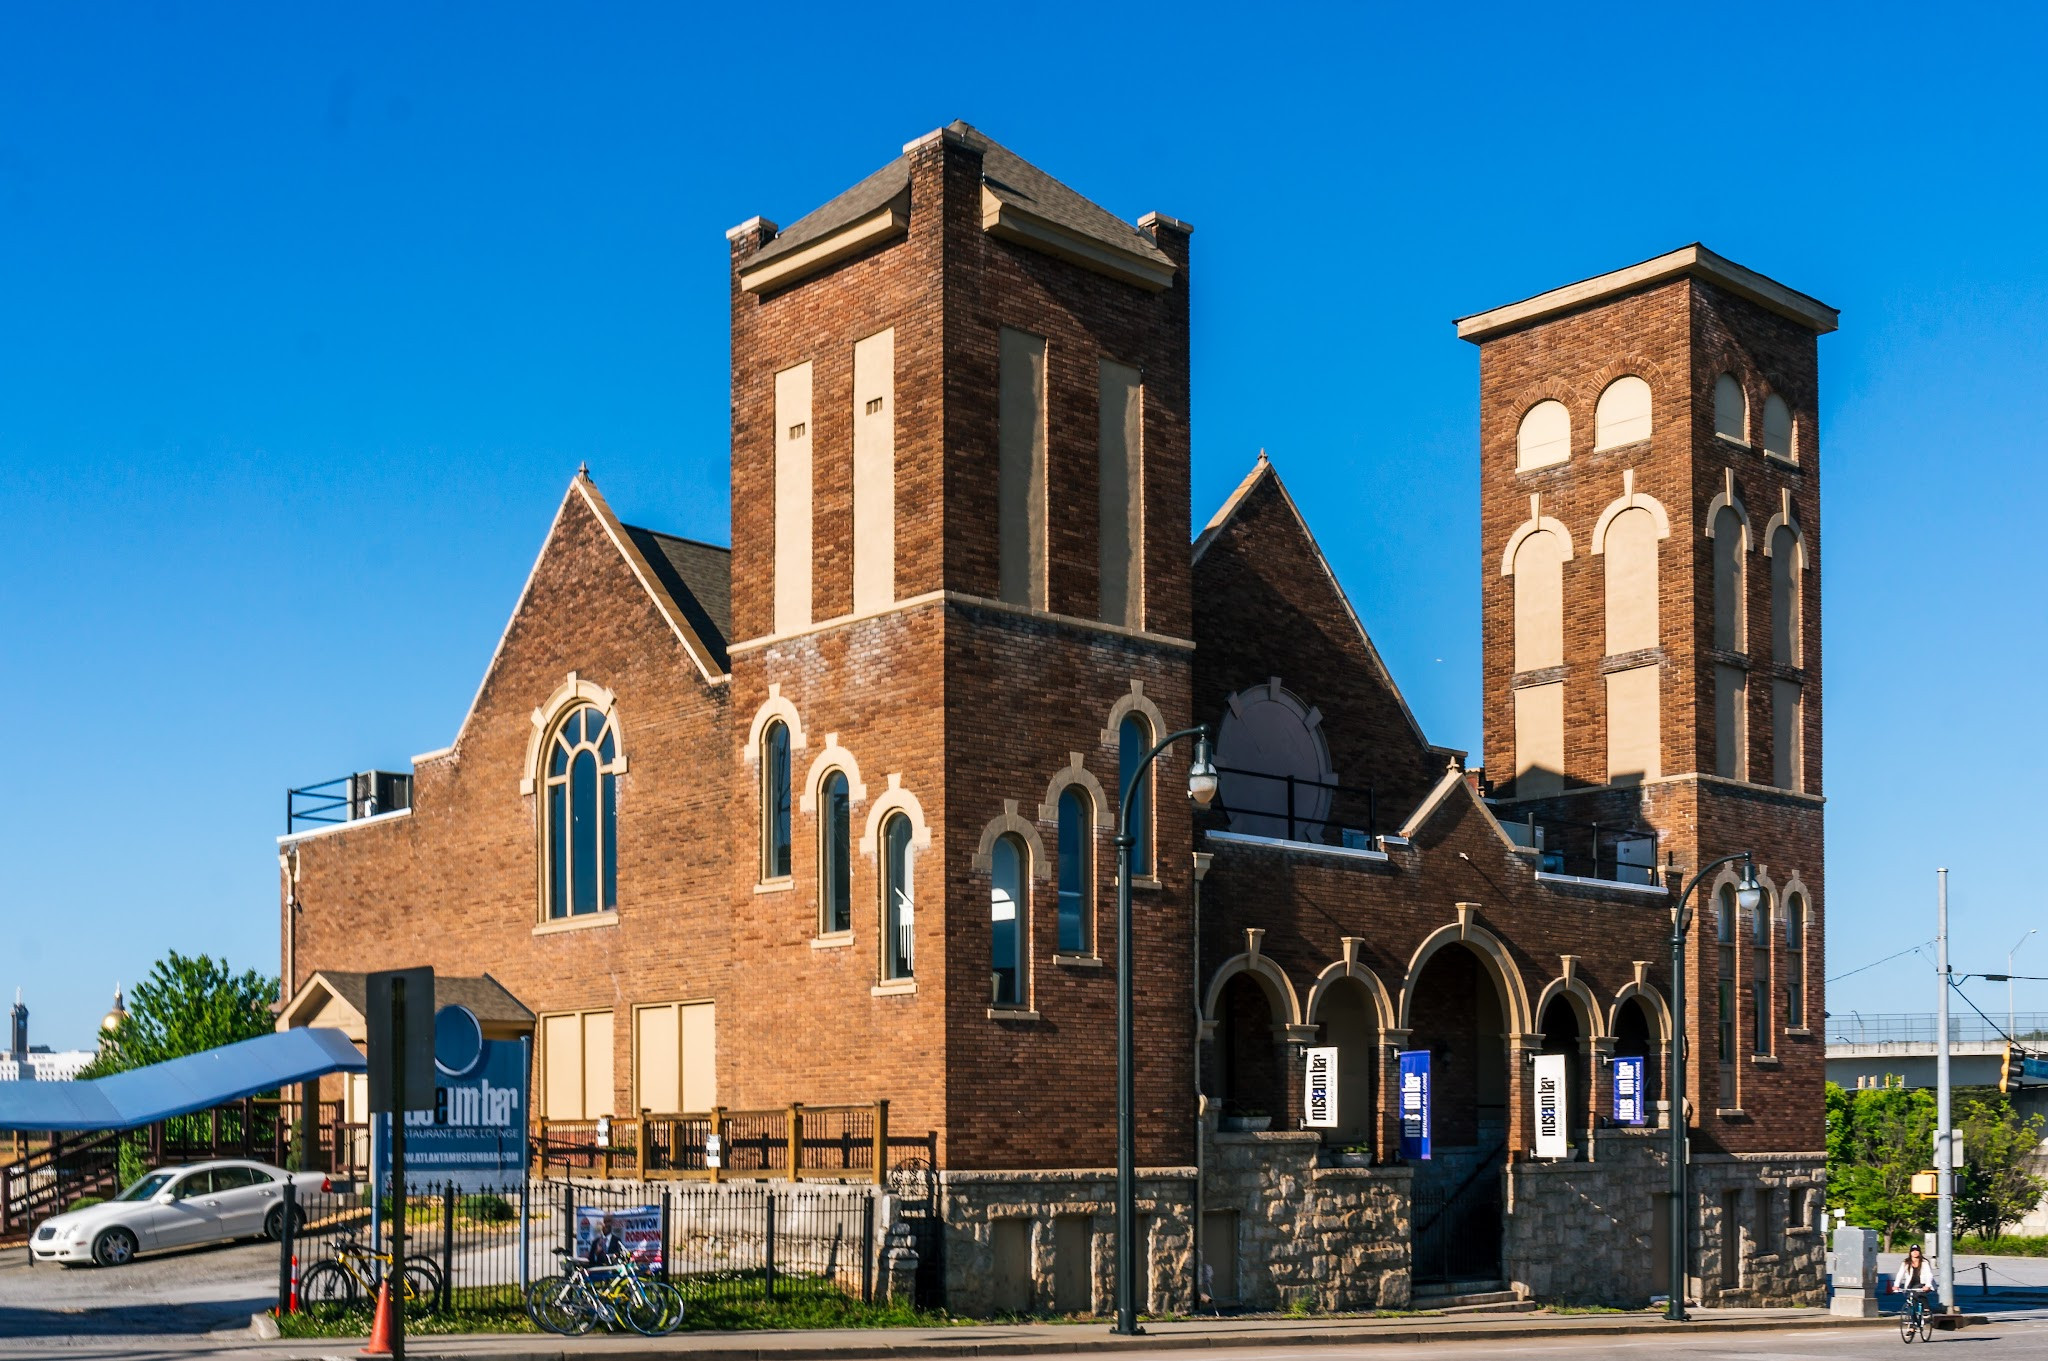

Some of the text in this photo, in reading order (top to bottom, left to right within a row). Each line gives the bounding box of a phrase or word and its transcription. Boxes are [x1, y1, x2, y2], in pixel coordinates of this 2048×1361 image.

[387, 1086, 479, 1126] eum
[388, 1128, 454, 1139] RSTAURANT,
[480, 1128, 519, 1139] LOUNGE
[387, 1151, 519, 1164] WW.ATLANTAMUSEUMBAR.COM
